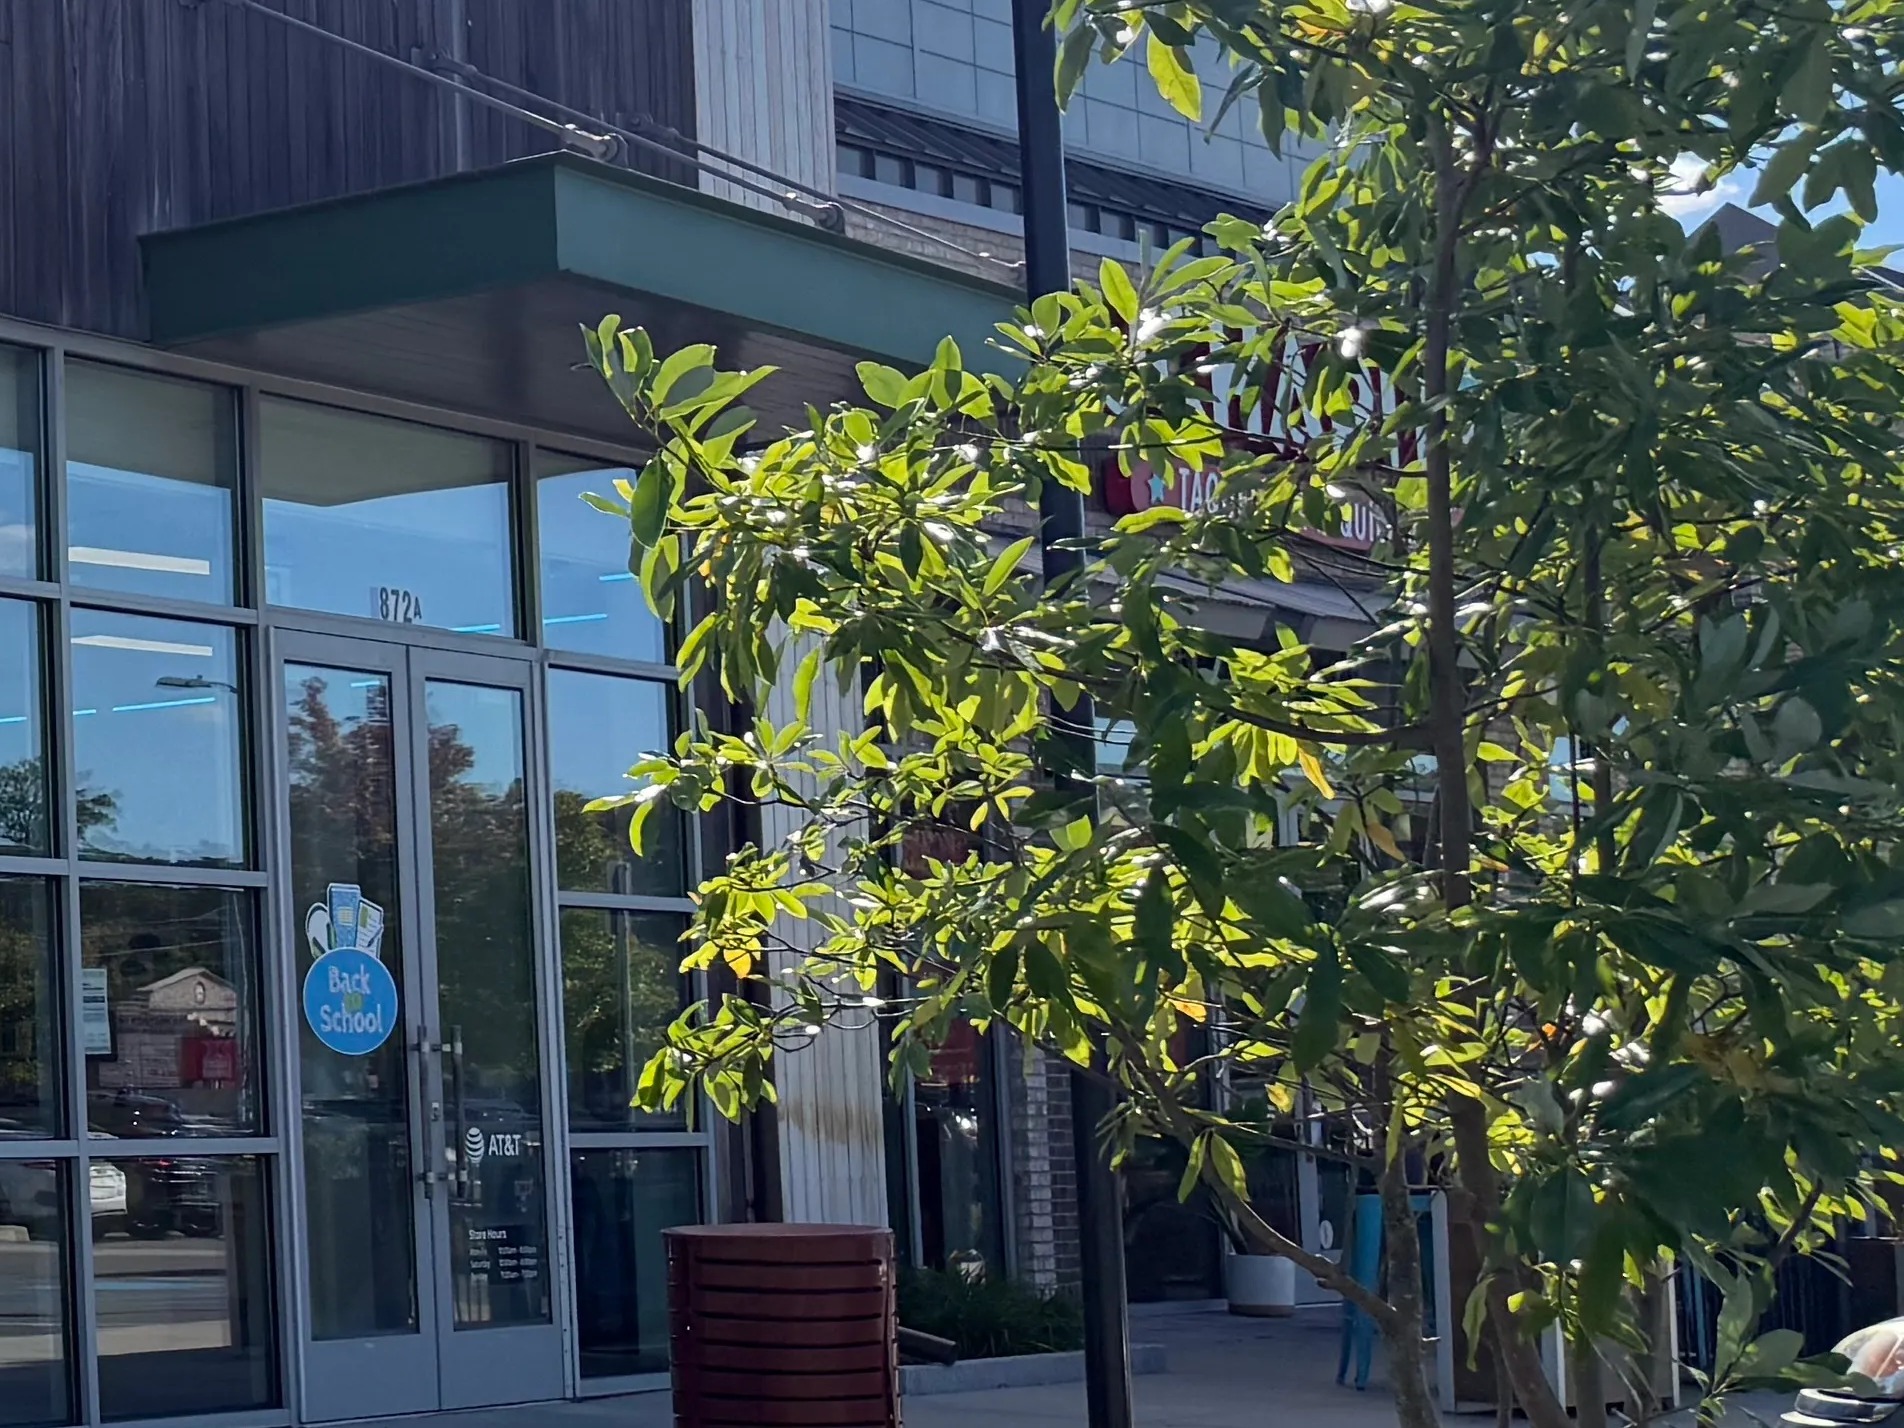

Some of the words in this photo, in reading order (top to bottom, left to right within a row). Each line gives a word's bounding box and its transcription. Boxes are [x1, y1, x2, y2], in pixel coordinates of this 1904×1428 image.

[328, 964, 371, 994] Back
[320, 1003, 383, 1033] School
[488, 1134, 522, 1156] AT&T
